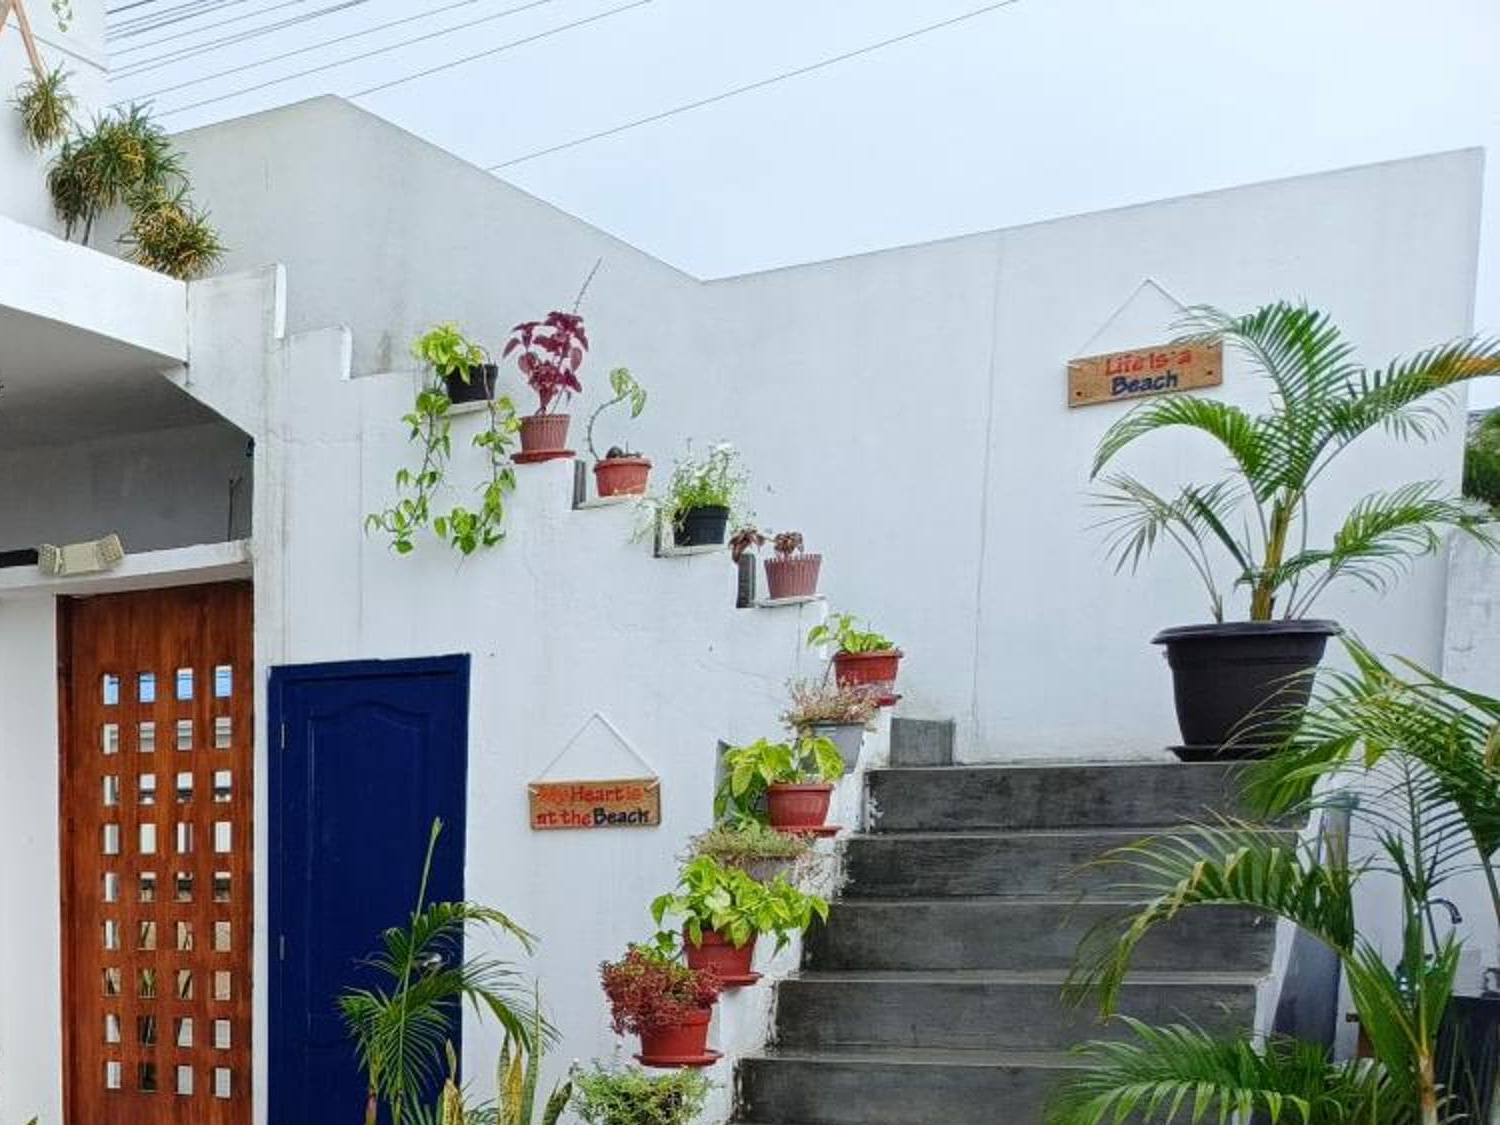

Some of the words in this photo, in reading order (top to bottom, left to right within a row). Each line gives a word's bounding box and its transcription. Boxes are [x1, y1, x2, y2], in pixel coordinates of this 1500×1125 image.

[1106, 353, 1144, 376] Life
[1111, 369, 1179, 396] Beach
[572, 784, 624, 803] Heart
[536, 810, 557, 825] at
[561, 809, 592, 826] the
[593, 806, 650, 826] Beach
